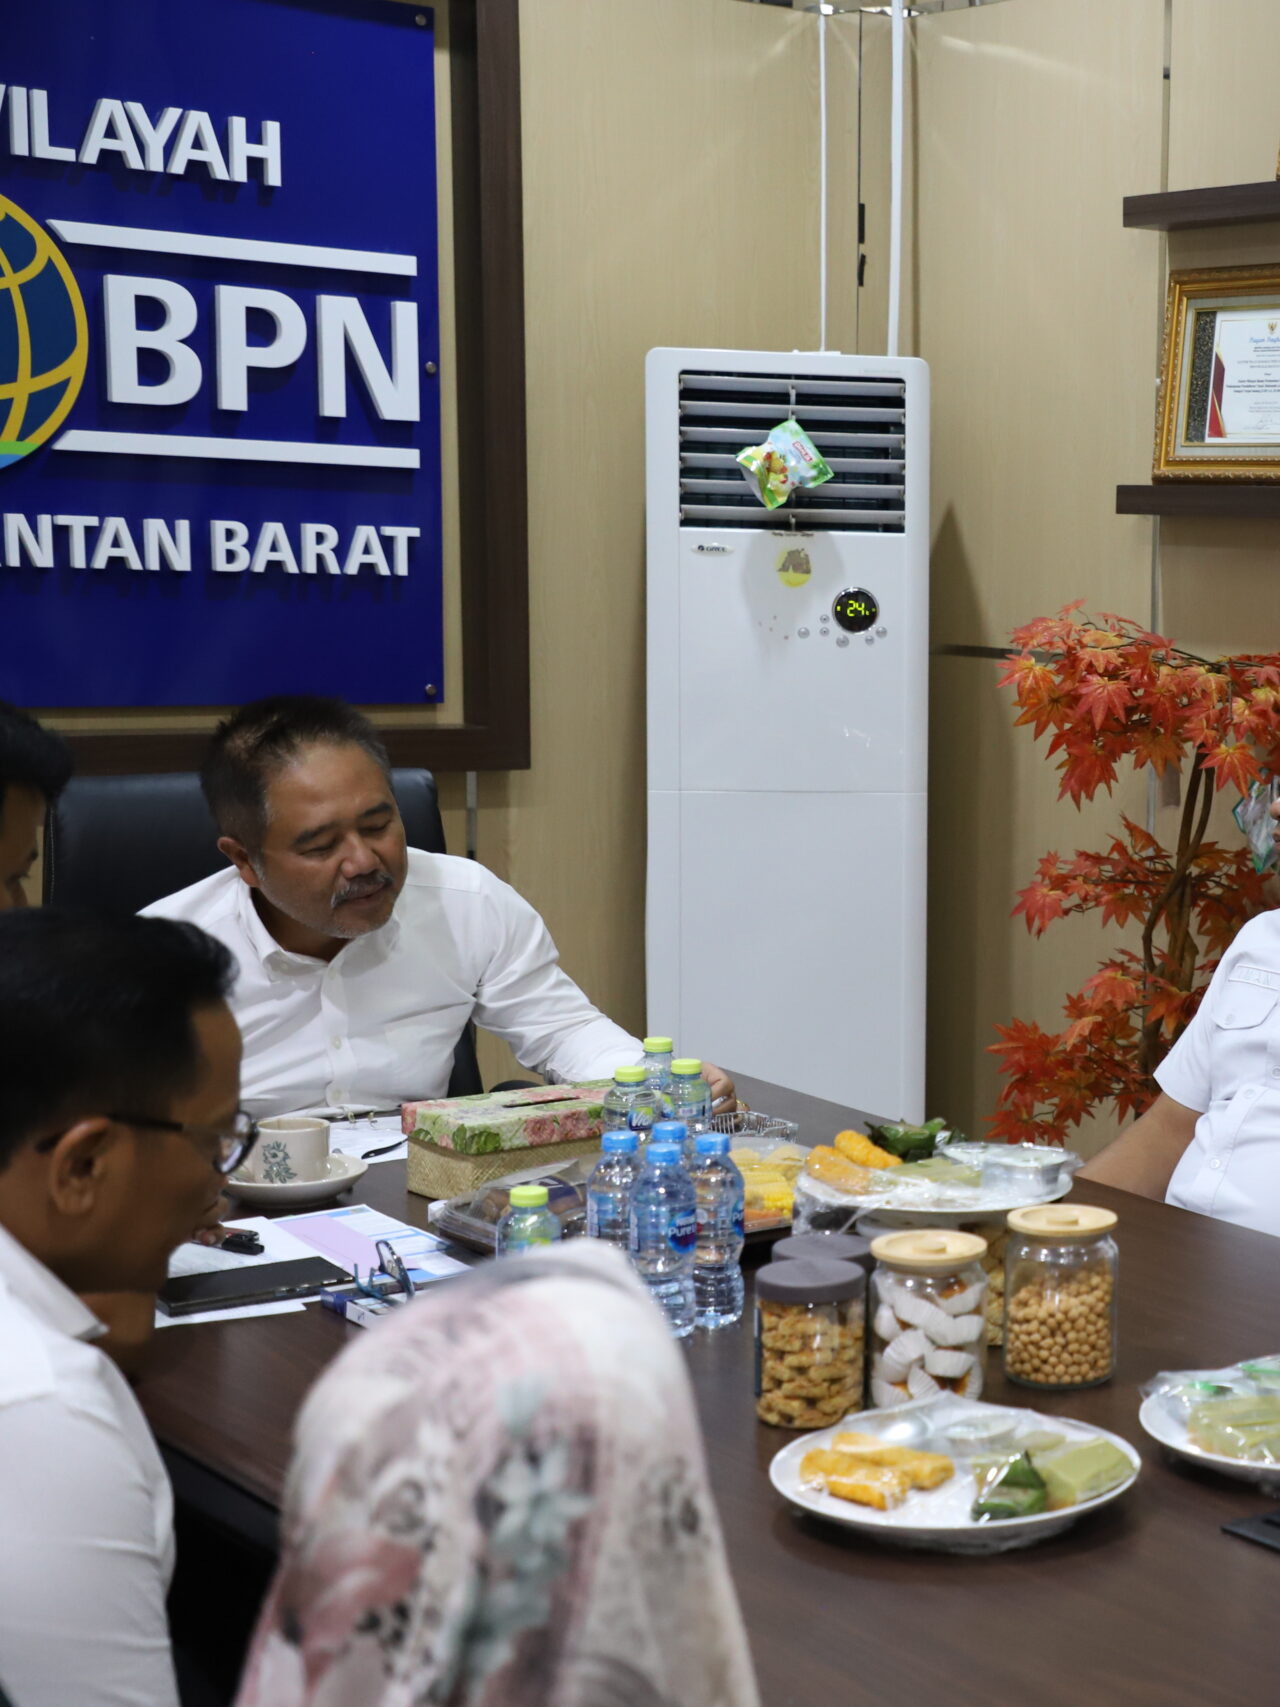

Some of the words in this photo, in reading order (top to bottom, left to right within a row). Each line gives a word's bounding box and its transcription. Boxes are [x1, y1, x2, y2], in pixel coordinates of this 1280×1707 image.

[103, 273, 420, 423] BPN
[0, 513, 190, 571] NTAN
[211, 519, 420, 576] BARAT
[847, 600, 865, 617] 24
